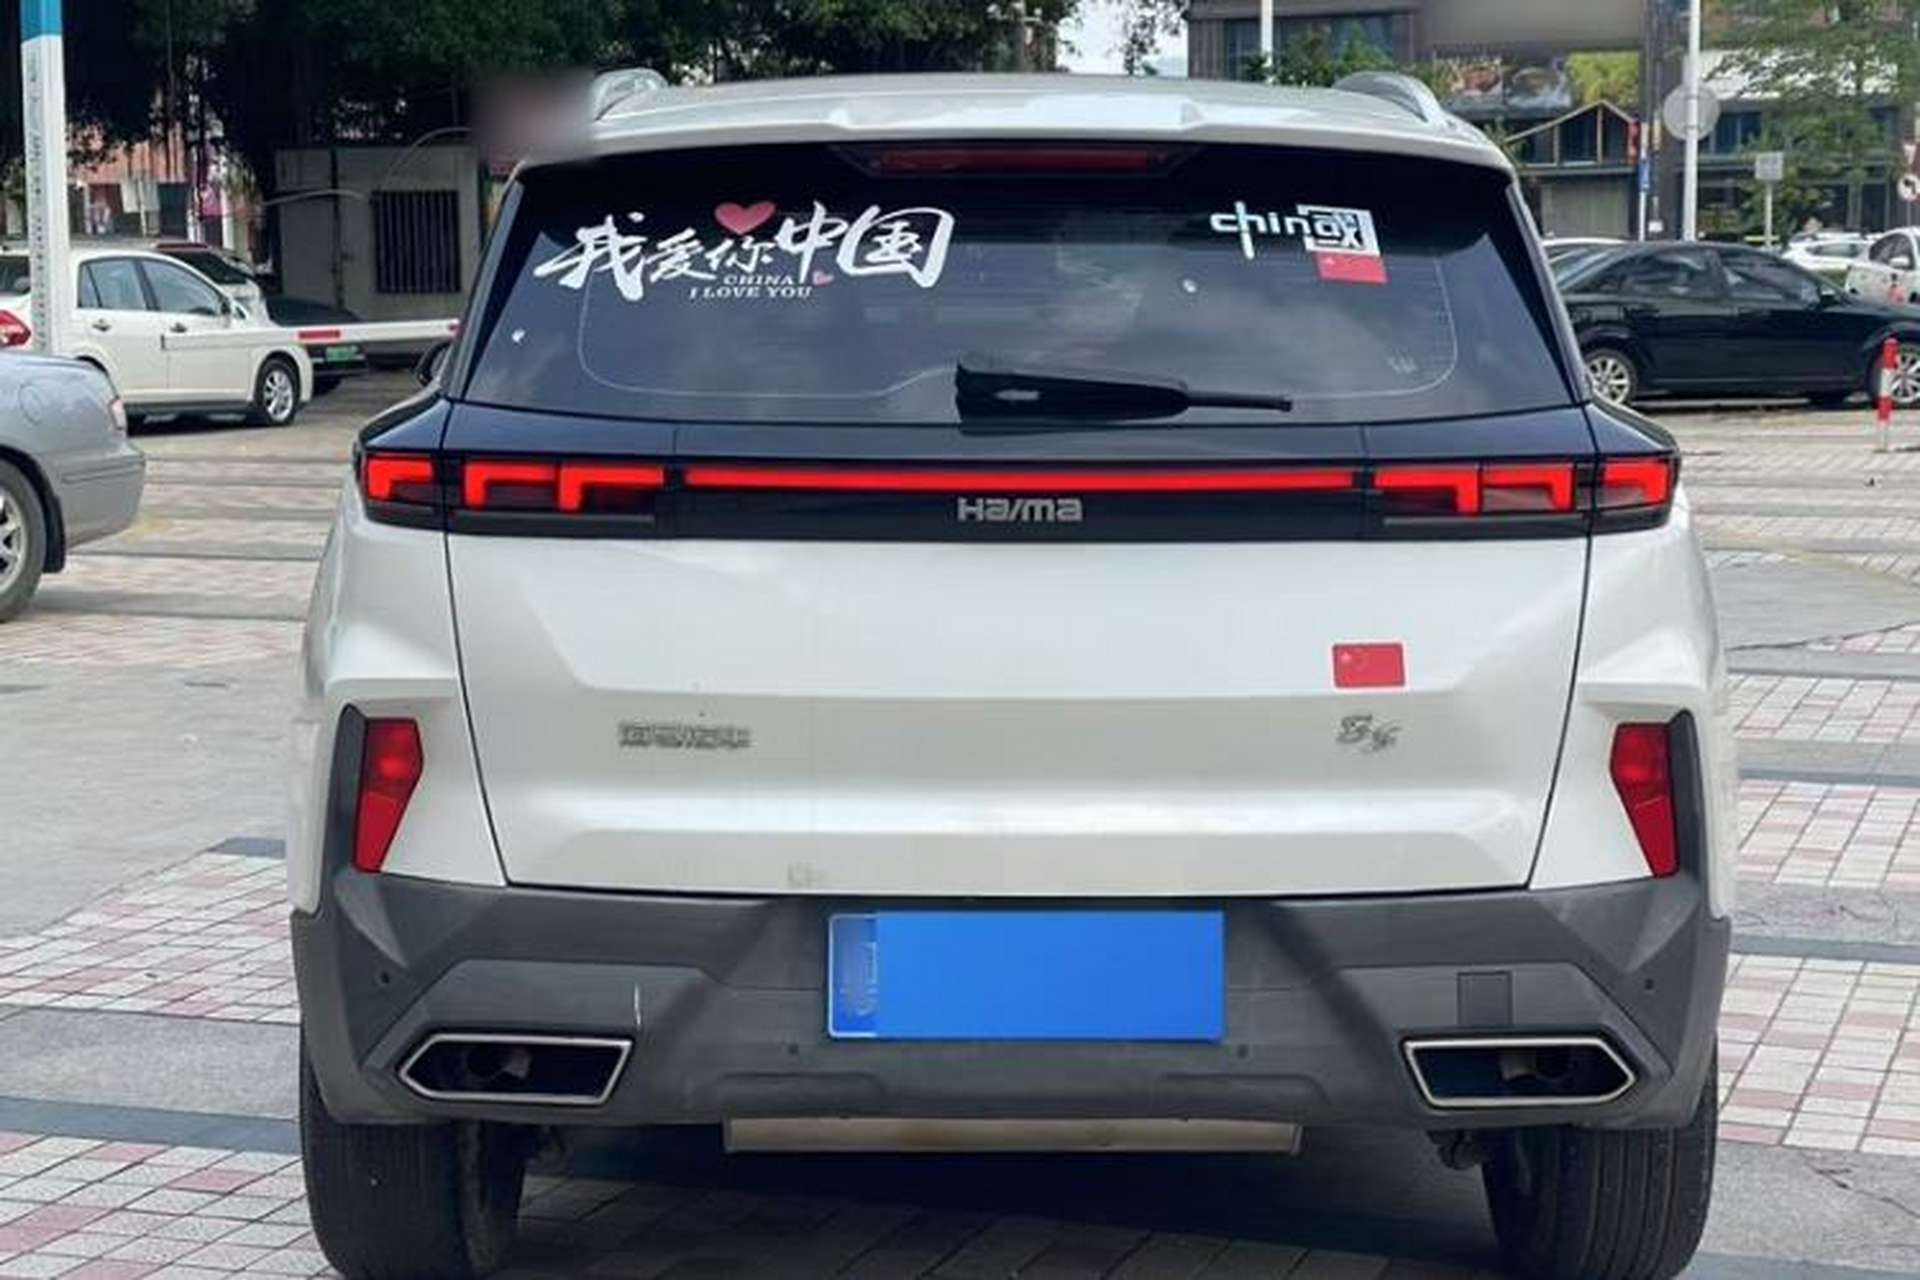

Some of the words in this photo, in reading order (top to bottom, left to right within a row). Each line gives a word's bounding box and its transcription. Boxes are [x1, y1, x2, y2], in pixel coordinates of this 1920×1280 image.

[534, 201, 955, 301] 我爱你中国
[723, 274, 794, 286] CHINA
[689, 286, 698, 299] I
[703, 286, 760, 299] LOVE
[767, 286, 813, 299] YOU
